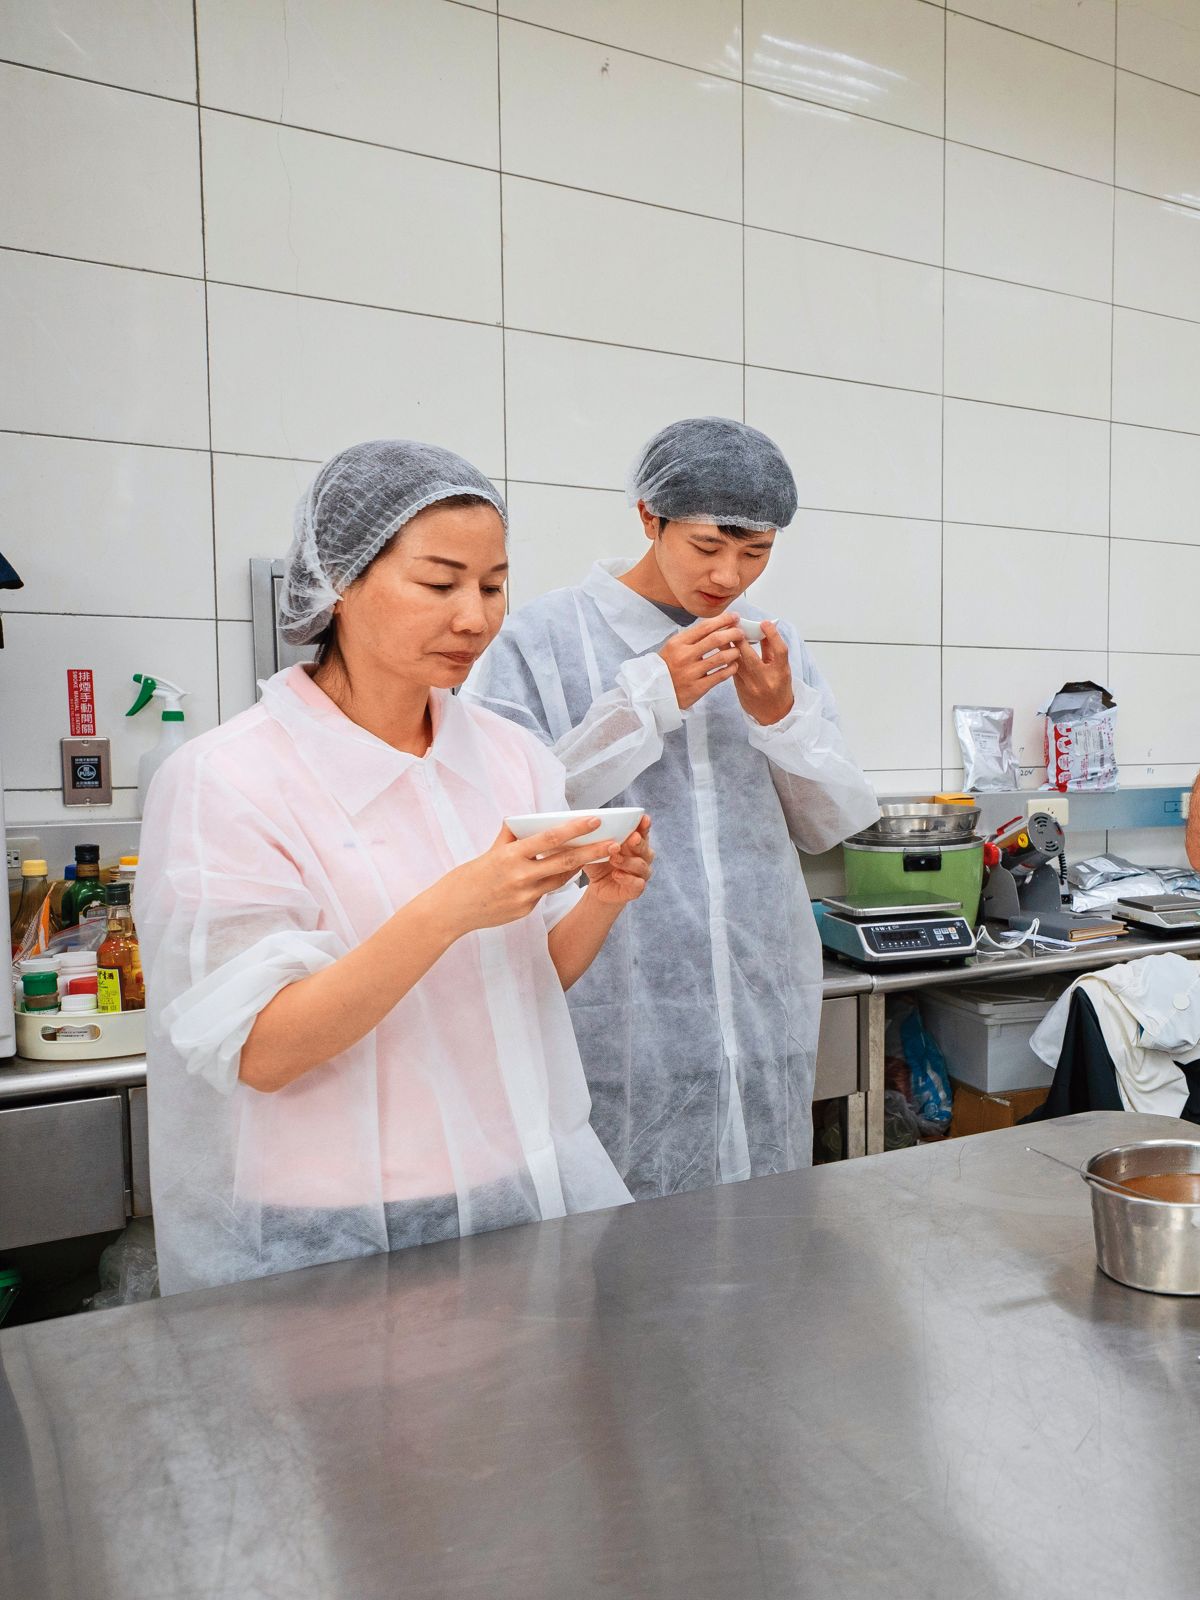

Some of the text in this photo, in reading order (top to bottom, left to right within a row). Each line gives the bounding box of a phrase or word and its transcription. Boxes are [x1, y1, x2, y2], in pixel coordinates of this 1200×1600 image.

[78, 671, 94, 735] 排煙手動開關
